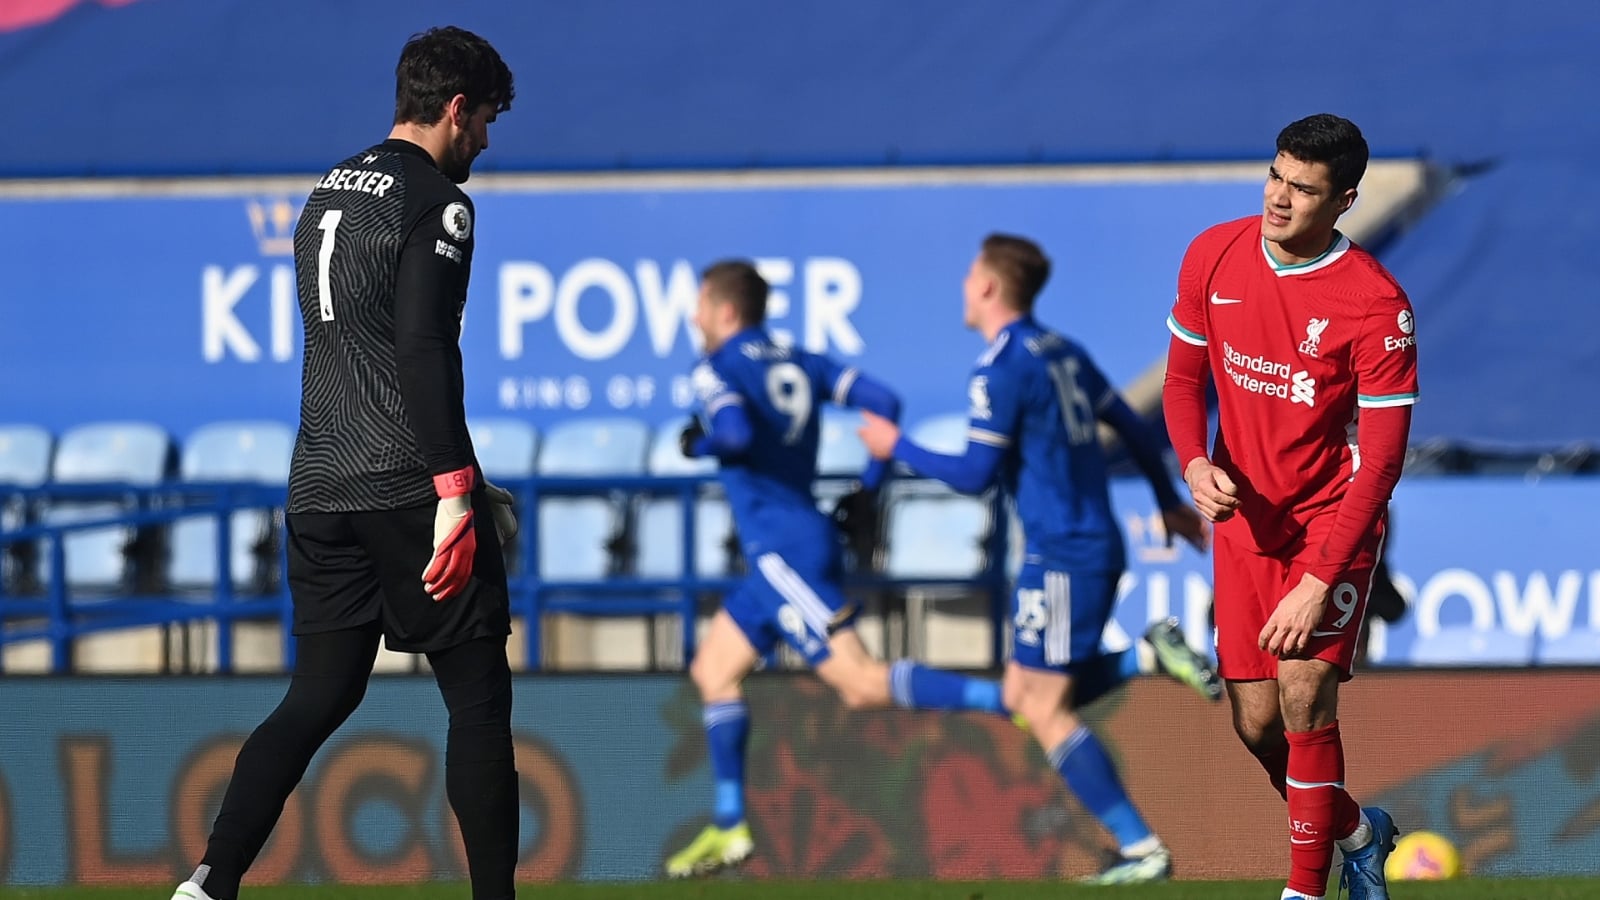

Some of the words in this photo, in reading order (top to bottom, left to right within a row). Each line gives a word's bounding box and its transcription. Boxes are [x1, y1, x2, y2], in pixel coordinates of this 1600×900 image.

[318, 209, 343, 322] 1
[498, 257, 865, 360] POWER
[1298, 342, 1319, 358] LFC
[1223, 341, 1291, 380] Standard
[765, 361, 812, 446] 9
[1331, 582, 1358, 628] 9
[58, 730, 584, 885] LOCO
